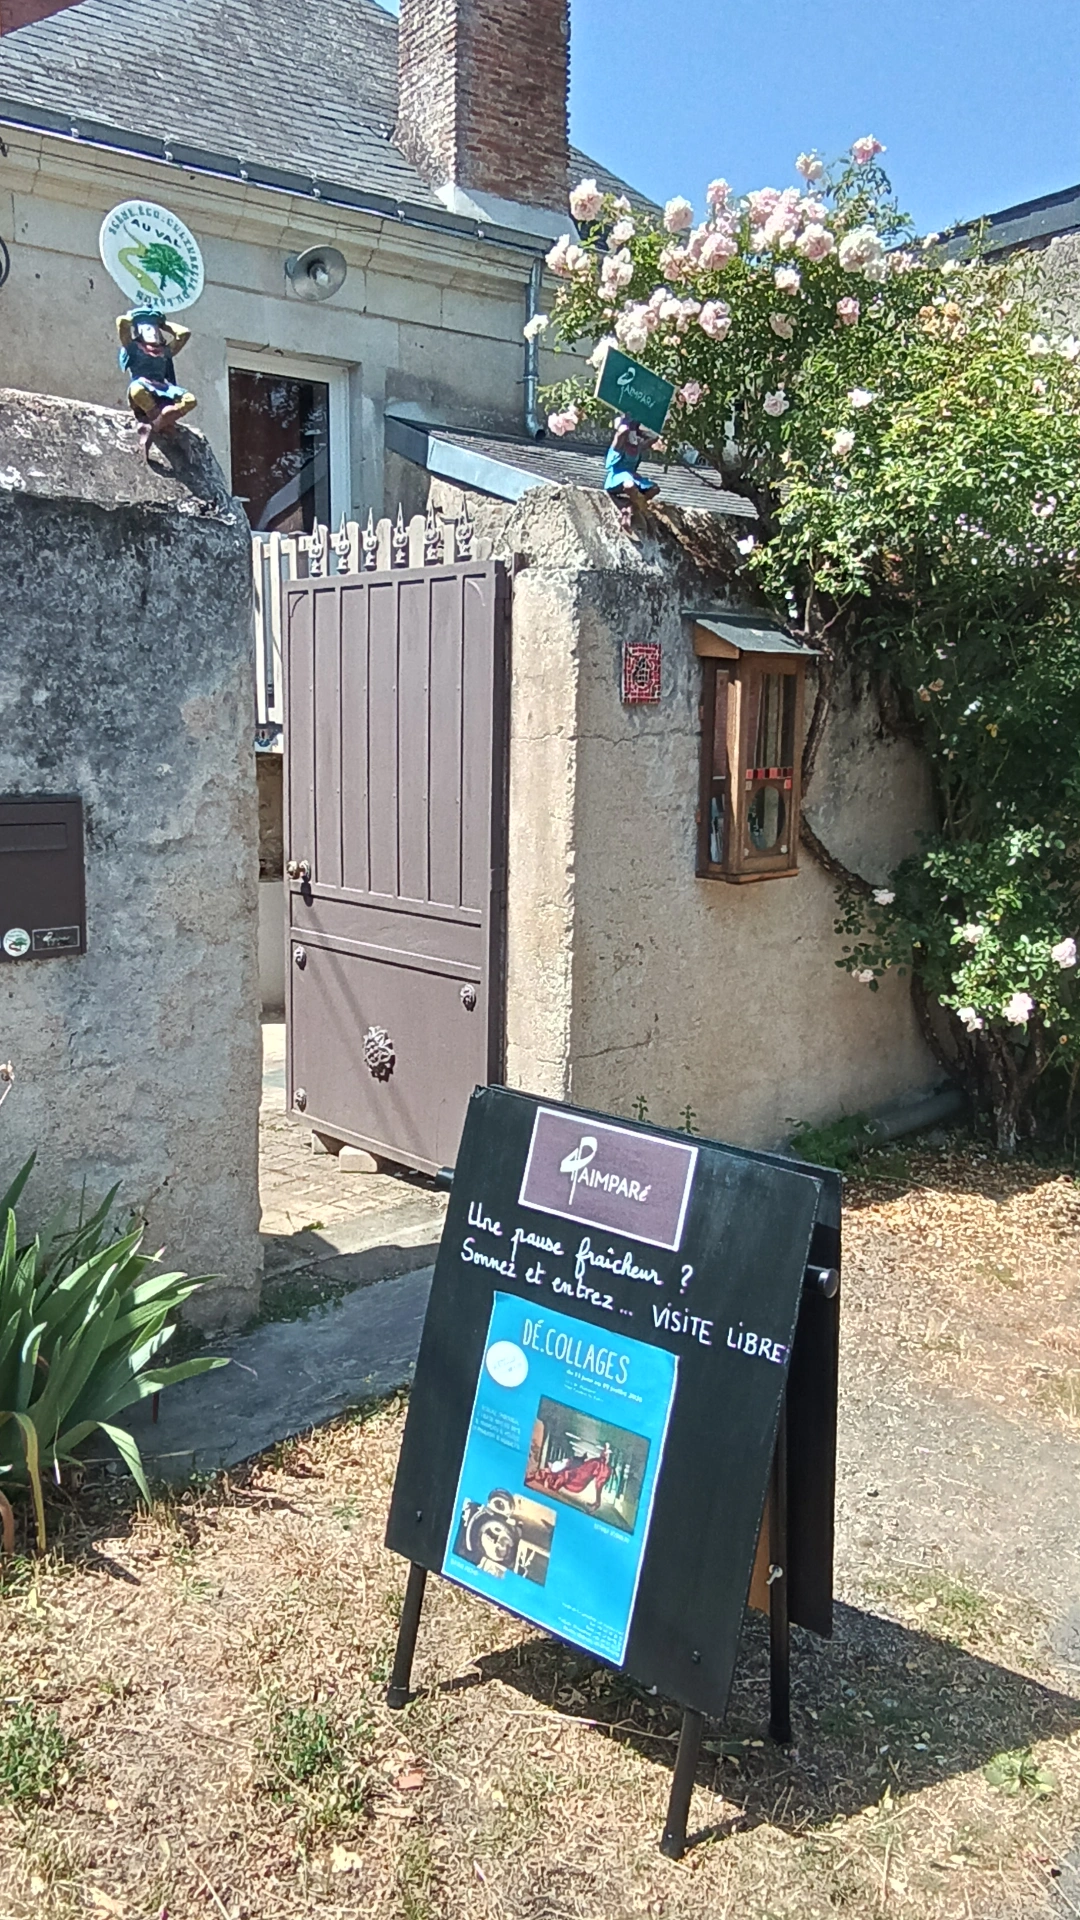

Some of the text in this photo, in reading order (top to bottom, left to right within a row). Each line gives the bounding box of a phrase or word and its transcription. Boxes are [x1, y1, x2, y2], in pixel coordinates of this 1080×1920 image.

[131, 218, 181, 248] AU VAL
[460, 1237, 517, 1278] Sonnez
[525, 1261, 545, 1286] et
[467, 1200, 693, 1295] Une pause fraîcheur ?
